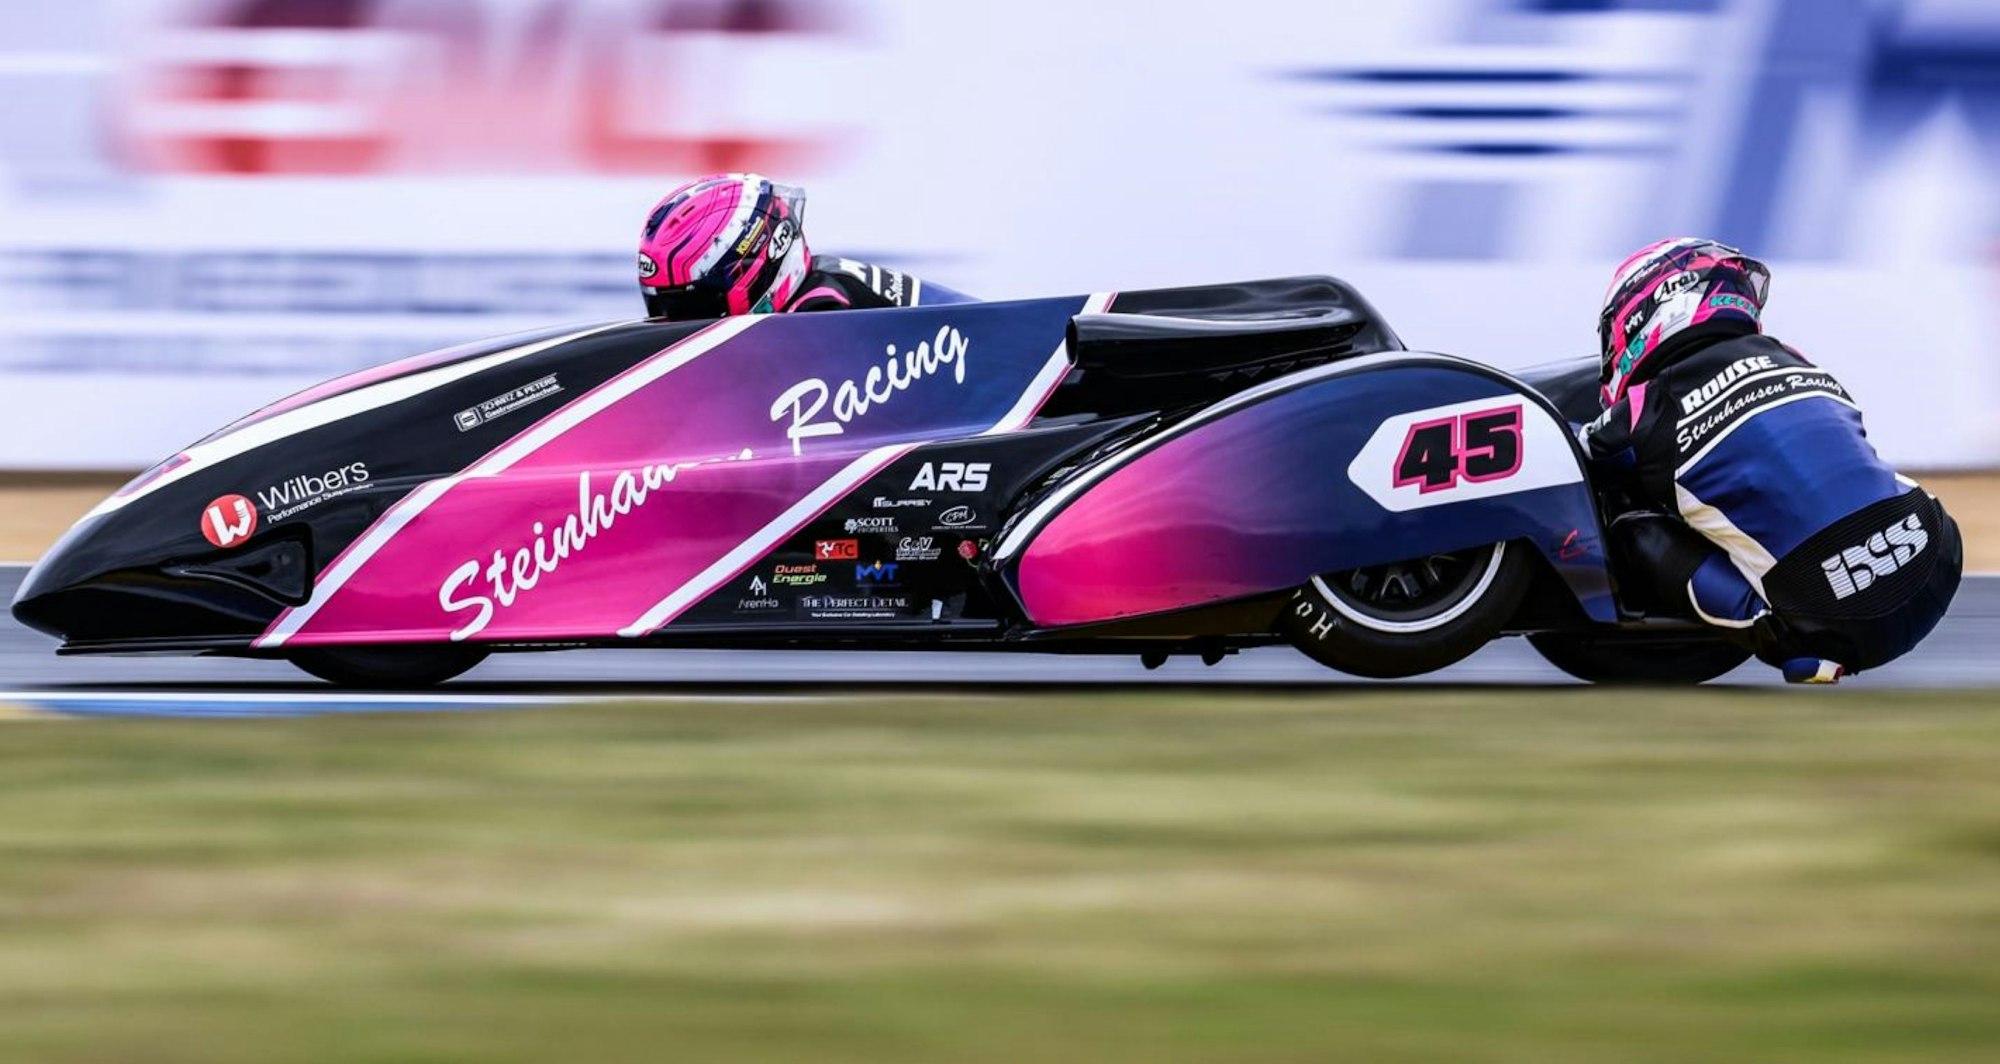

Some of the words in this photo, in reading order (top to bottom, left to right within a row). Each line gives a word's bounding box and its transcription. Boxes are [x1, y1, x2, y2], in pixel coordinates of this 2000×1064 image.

[1656, 272, 1695, 302] Arai
[1680, 355, 1779, 415] ROUSSE
[1676, 382, 1786, 453] Steinhausen
[1785, 375, 1844, 396] Racing
[1393, 403, 1524, 495] 45
[257, 461, 370, 510] Wilbers
[439, 448, 754, 642] Steinhau
[770, 325, 969, 457] Racing
[908, 462, 992, 491] ARS
[267, 497, 322, 524] Performance
[857, 517, 895, 526] SCOTT
[857, 526, 899, 534] PROPERTIES
[773, 573, 827, 586] Energie
[802, 595, 821, 608] THE
[823, 595, 869, 608] PERFECT
[871, 595, 908, 608] DETAIL
